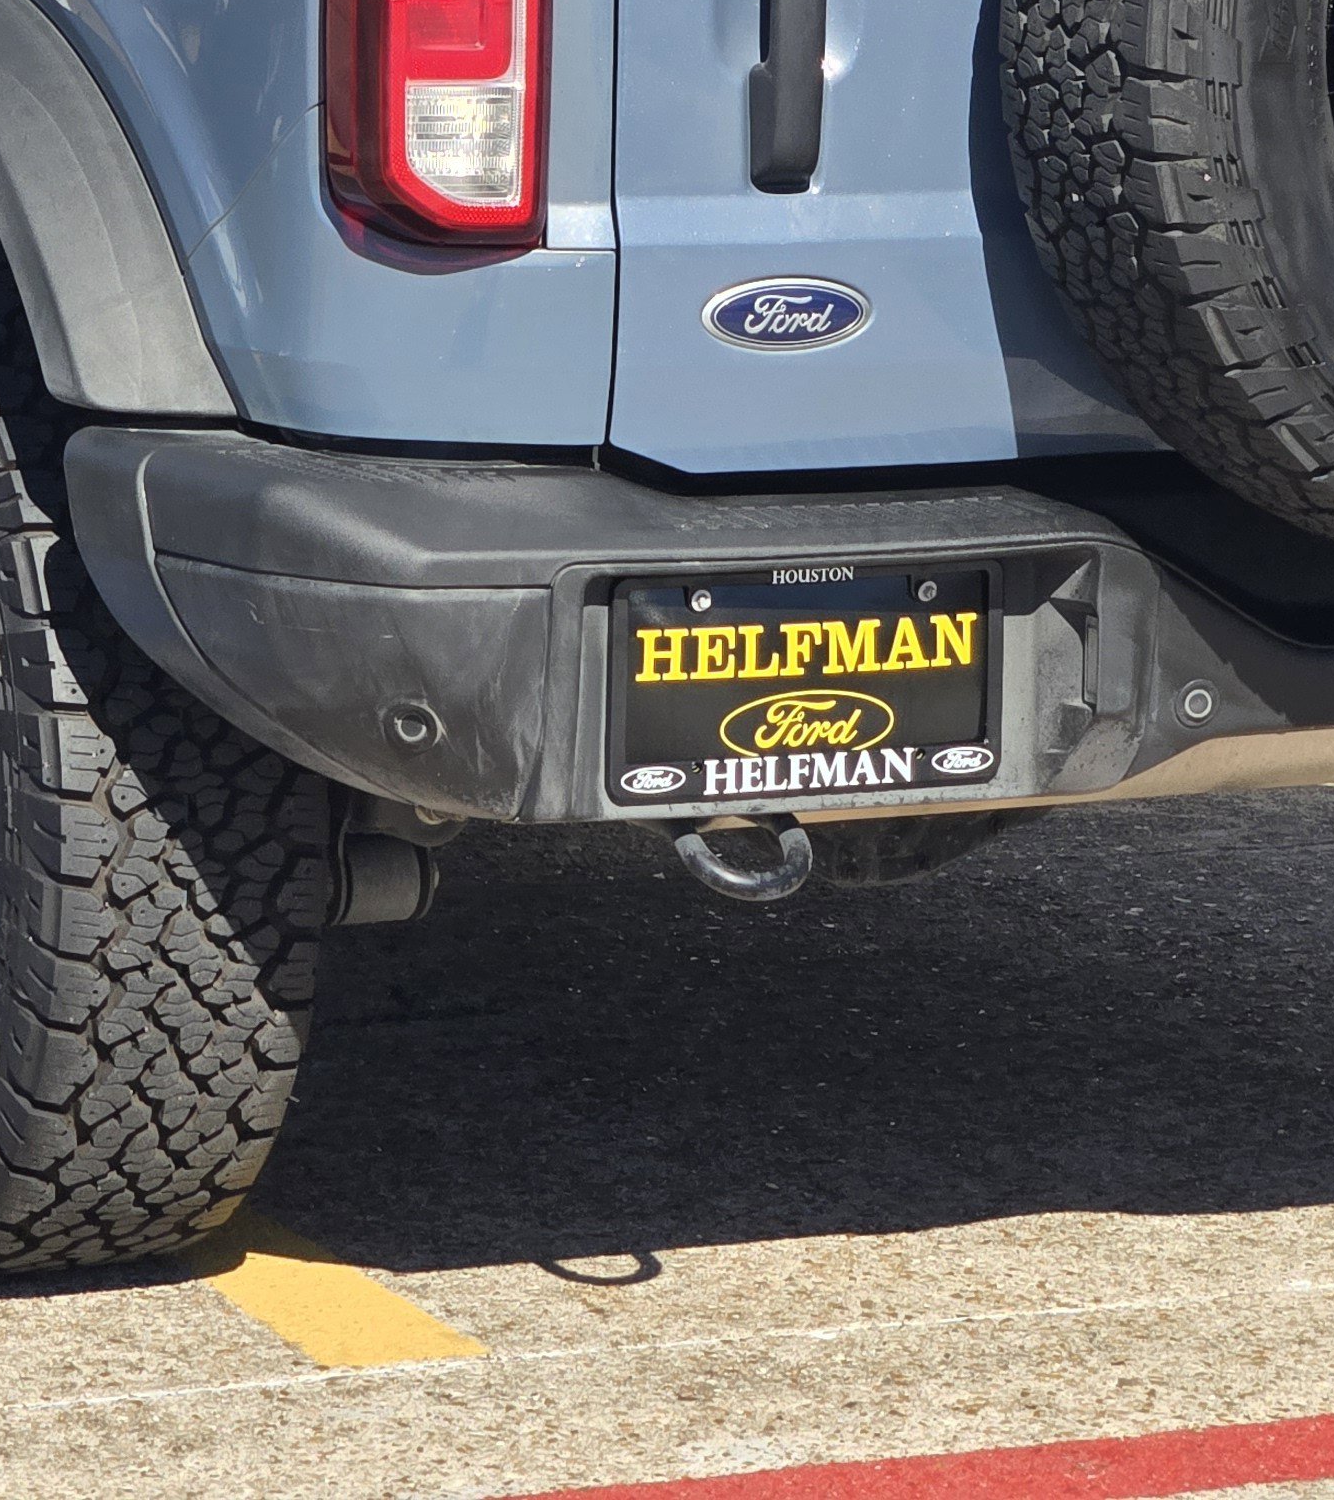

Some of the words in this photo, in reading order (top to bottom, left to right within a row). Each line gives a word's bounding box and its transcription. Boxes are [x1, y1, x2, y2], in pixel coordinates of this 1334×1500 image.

[743, 293, 835, 335] Ford
[771, 566, 855, 585] HOUSTON
[634, 611, 978, 683] HELFMAN
[753, 699, 862, 750] Ford
[631, 769, 674, 790] Ford
[702, 746, 915, 797] HELFMAN
[941, 749, 982, 770] Ford
